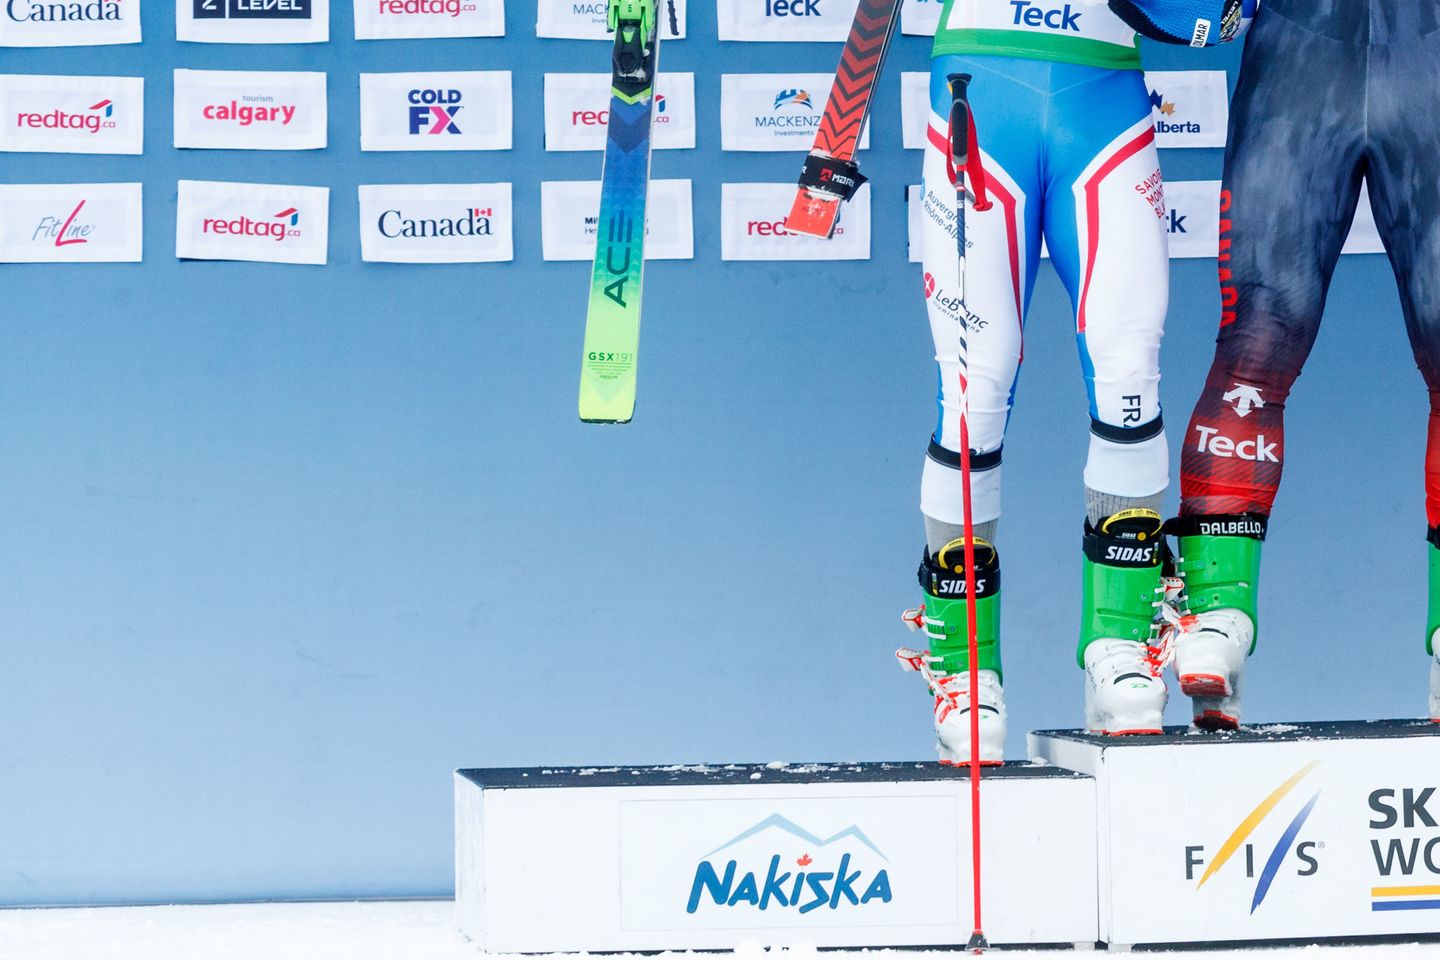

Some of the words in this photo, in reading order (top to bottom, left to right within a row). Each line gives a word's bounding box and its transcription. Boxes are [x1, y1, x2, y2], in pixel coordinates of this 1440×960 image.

[1009, 1, 1082, 32] Teck
[408, 89, 462, 104] COLD
[18, 110, 115, 133] redtag.ca
[203, 102, 295, 126] calgary
[409, 106, 464, 134] FX
[755, 116, 819, 127] MACKENZ
[204, 216, 300, 241] redtag.ca
[377, 209, 493, 237] Canada
[604, 209, 633, 308] ACE
[588, 352, 614, 361] GSX
[1122, 394, 1141, 427] FR
[1195, 425, 1280, 464] Teck
[1200, 522, 1261, 535] DALBELLO
[1105, 546, 1153, 562] SIDAS
[939, 579, 986, 593] SIDS
[1185, 840, 1319, 880] FIS
